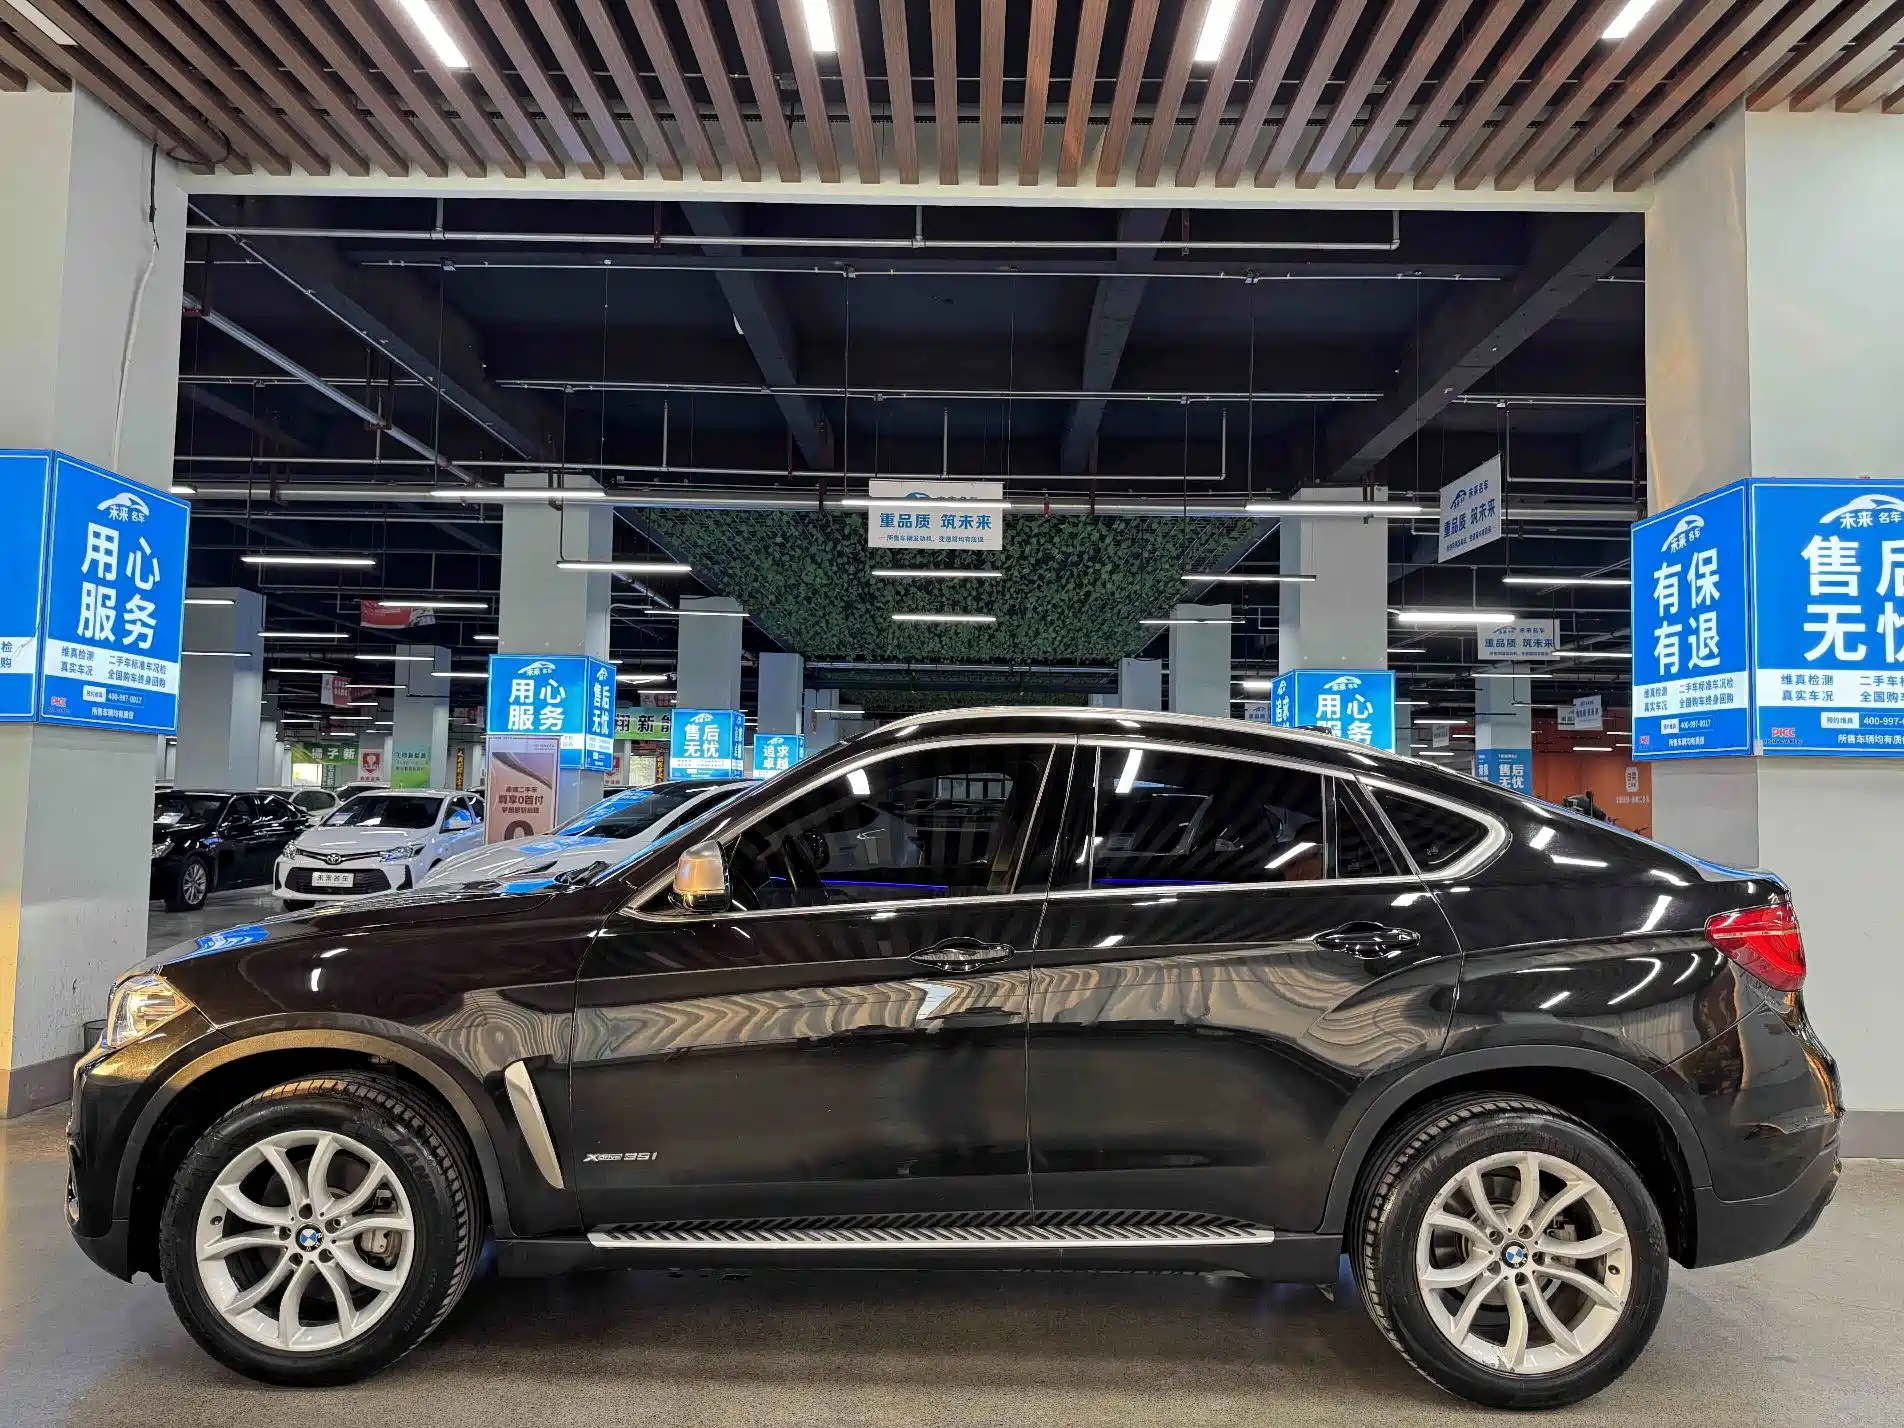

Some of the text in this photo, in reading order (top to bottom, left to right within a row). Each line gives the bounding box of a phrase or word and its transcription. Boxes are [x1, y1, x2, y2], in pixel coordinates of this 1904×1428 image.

[109, 505, 128, 522] 未来
[879, 512, 992, 530] 重品质 筑未来
[1444, 498, 1496, 538] 重品质 筑未来
[1840, 511, 1902, 529] 未来 名车
[81, 521, 161, 591] 用心
[1653, 547, 1721, 617] 有保
[77, 581, 158, 650] 服务
[1484, 638, 1555, 648] 重品质 筑未来
[1653, 611, 1721, 676] 有退
[61, 646, 95, 662] 维真检测
[60, 661, 94, 677] 真实车况
[1780, 674, 1835, 686] 维真检测
[508, 679, 566, 704] 用心
[593, 682, 611, 710] 售后
[1781, 690, 1835, 702] 真实车况
[1316, 694, 1374, 719] 用心
[1644, 700, 1668, 713] 真实车况
[507, 705, 565, 732] 服务
[684, 724, 720, 741] 售后
[1772, 728, 1795, 737] PICC
[683, 741, 720, 758] 无忧
[763, 745, 789, 757] 追求
[1499, 763, 1525, 776] 售后
[1499, 776, 1525, 788] 无忧
